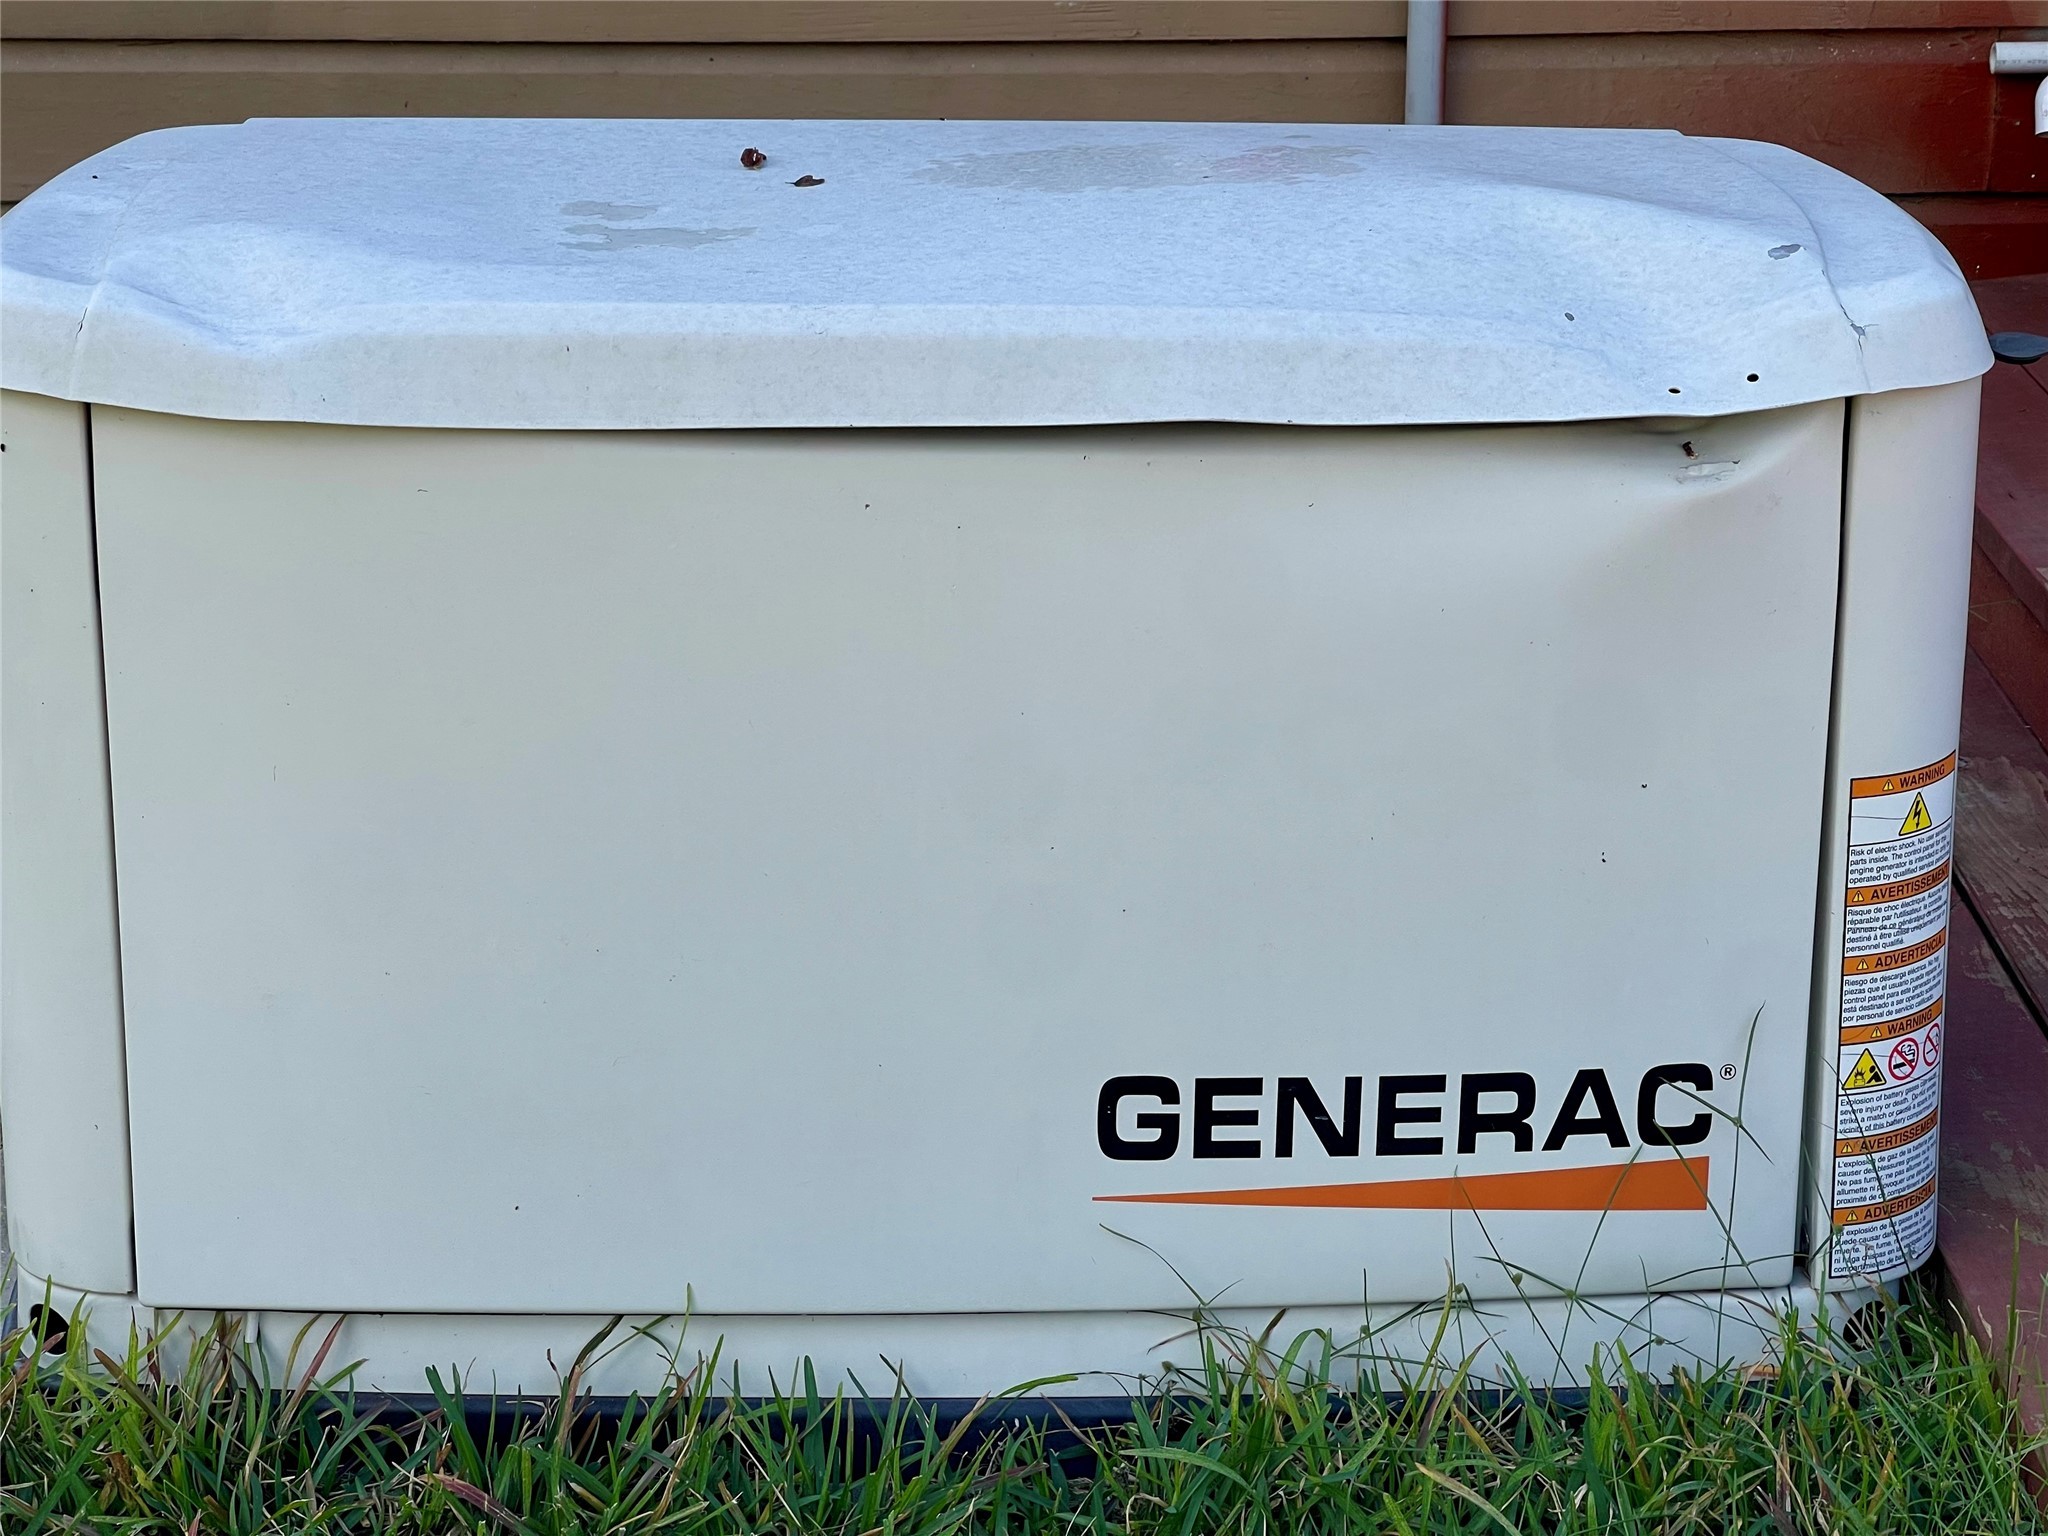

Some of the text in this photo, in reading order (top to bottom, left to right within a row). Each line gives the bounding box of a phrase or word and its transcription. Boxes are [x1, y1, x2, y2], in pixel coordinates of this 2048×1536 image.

[1900, 764, 1944, 788] WARNING
[1850, 858, 1867, 866] parts
[1869, 856, 1889, 864] inside.
[1904, 847, 1921, 857] control
[1923, 844, 1935, 853] panel
[1875, 845, 1897, 853] electric
[1849, 875, 1881, 884] operated
[1893, 866, 1917, 879] qualified
[1919, 860, 1934, 871] service
[1850, 867, 1874, 875] engine
[1876, 861, 1907, 873] generator
[1915, 851, 1933, 863] intended
[1871, 865, 1949, 900] AVERTISSEMENT
[1848, 909, 1872, 917] Risque
[1884, 903, 1899, 911] choc
[1901, 895, 1926, 908] électrique.
[1847, 926, 1877, 934] Panneau
[1898, 913, 1925, 927] générateur
[1848, 917, 1880, 926] réparable
[1882, 914, 1892, 922] par
[1846, 937, 1904, 953] personnel qualifié.
[1847, 935, 1872, 944] destiné
[1873, 933, 1877, 941] à
[1880, 931, 1891, 939] être
[1893, 928, 1910, 937] utilisé
[1874, 938, 1941, 968] ADVERTENCIA
[1844, 988, 1865, 996] piezas
[1867, 986, 1880, 994] que
[1888, 979, 1908, 989] usuario
[1910, 974, 1924, 984] pueda
[1845, 978, 1867, 987] Riesgo
[1880, 970, 1906, 982] descarga
[1844, 996, 1866, 1004] control
[1868, 994, 1885, 1002] panel
[1887, 991, 1899, 999] para
[1901, 987, 1911, 996] este
[1912, 978, 1932, 993] generador
[1843, 1005, 1857, 1013] está
[1859, 1001, 1889, 1011] destinado
[1896, 998, 1904, 1006] ser
[1906, 989, 1925, 1004] operado
[1856, 1012, 1884, 1022] personal
[1895, 1004, 1914, 1015] servicio
[1888, 1009, 1932, 1035] WARNING
[1841, 1096, 1874, 1106] Explosion
[1876, 1094, 1883, 1102] of
[1884, 1089, 1904, 1101] battery
[1905, 1085, 1919, 1095] gases
[1865, 1104, 1882, 1114] injury
[1893, 1096, 1909, 1108] death.
[1867, 1111, 1887, 1122] match
[1888, 1109, 1895, 1117] or
[1873, 1122, 1884, 1130] this
[1886, 1118, 1905, 1127] battery
[1838, 1157, 1877, 1168] L'explosi
[1887, 1153, 1898, 1162] gaz
[1878, 1159, 1905, 1172] blessures
[1836, 1187, 1867, 1196] allumette
[1877, 1179, 1905, 1193] povoquer
[1906, 1173, 1915, 1181] une
[1849, 1179, 1862, 1187] pas
[1864, 1174, 1884, 1184] fumr,
[1895, 1168, 1905, 1178] pas
[1836, 1195, 1867, 1206] proximité
[1864, 1184, 1931, 1219] ADVERTENCIA
[1846, 1227, 1878, 1236] explosión
[1889, 1221, 1897, 1229] ls
[1859, 1234, 1881, 1245] causar
[1876, 1240, 1892, 1249] fume,
[1833, 1259, 1885, 1273] comartimieto
[1842, 1255, 1863, 1264] hga
